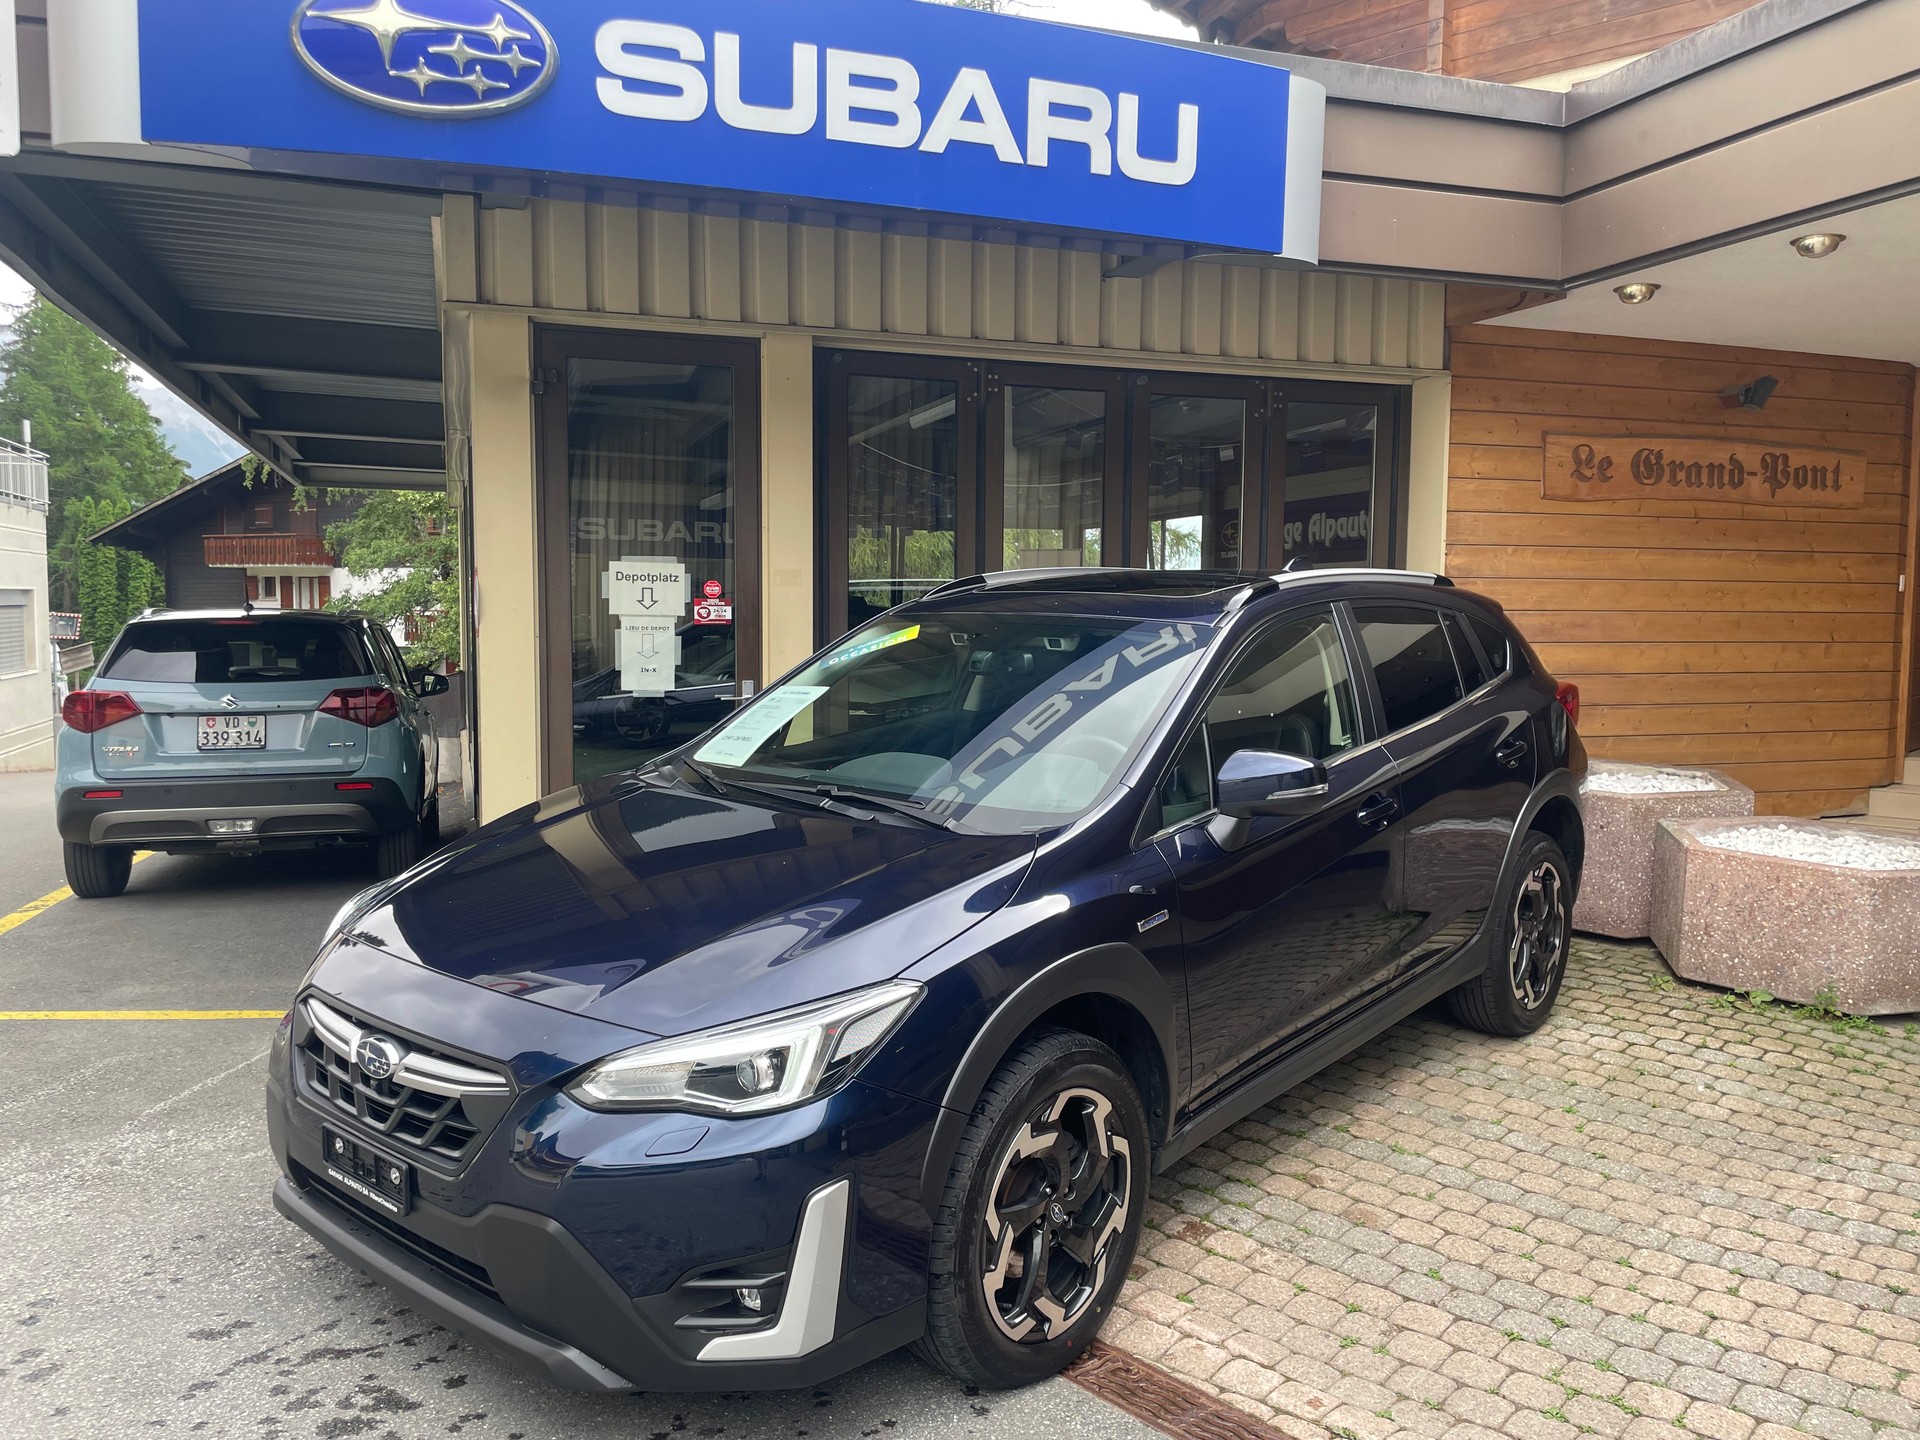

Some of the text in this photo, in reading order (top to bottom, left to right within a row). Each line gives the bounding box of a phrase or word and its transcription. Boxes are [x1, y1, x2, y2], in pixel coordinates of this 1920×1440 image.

[595, 18, 1199, 186] SUBARU
[1570, 443, 1843, 500] Le Grand-Pont
[615, 571, 680, 584] Depotplatz
[224, 717, 240, 729] VD
[201, 729, 263, 747] 339 314
